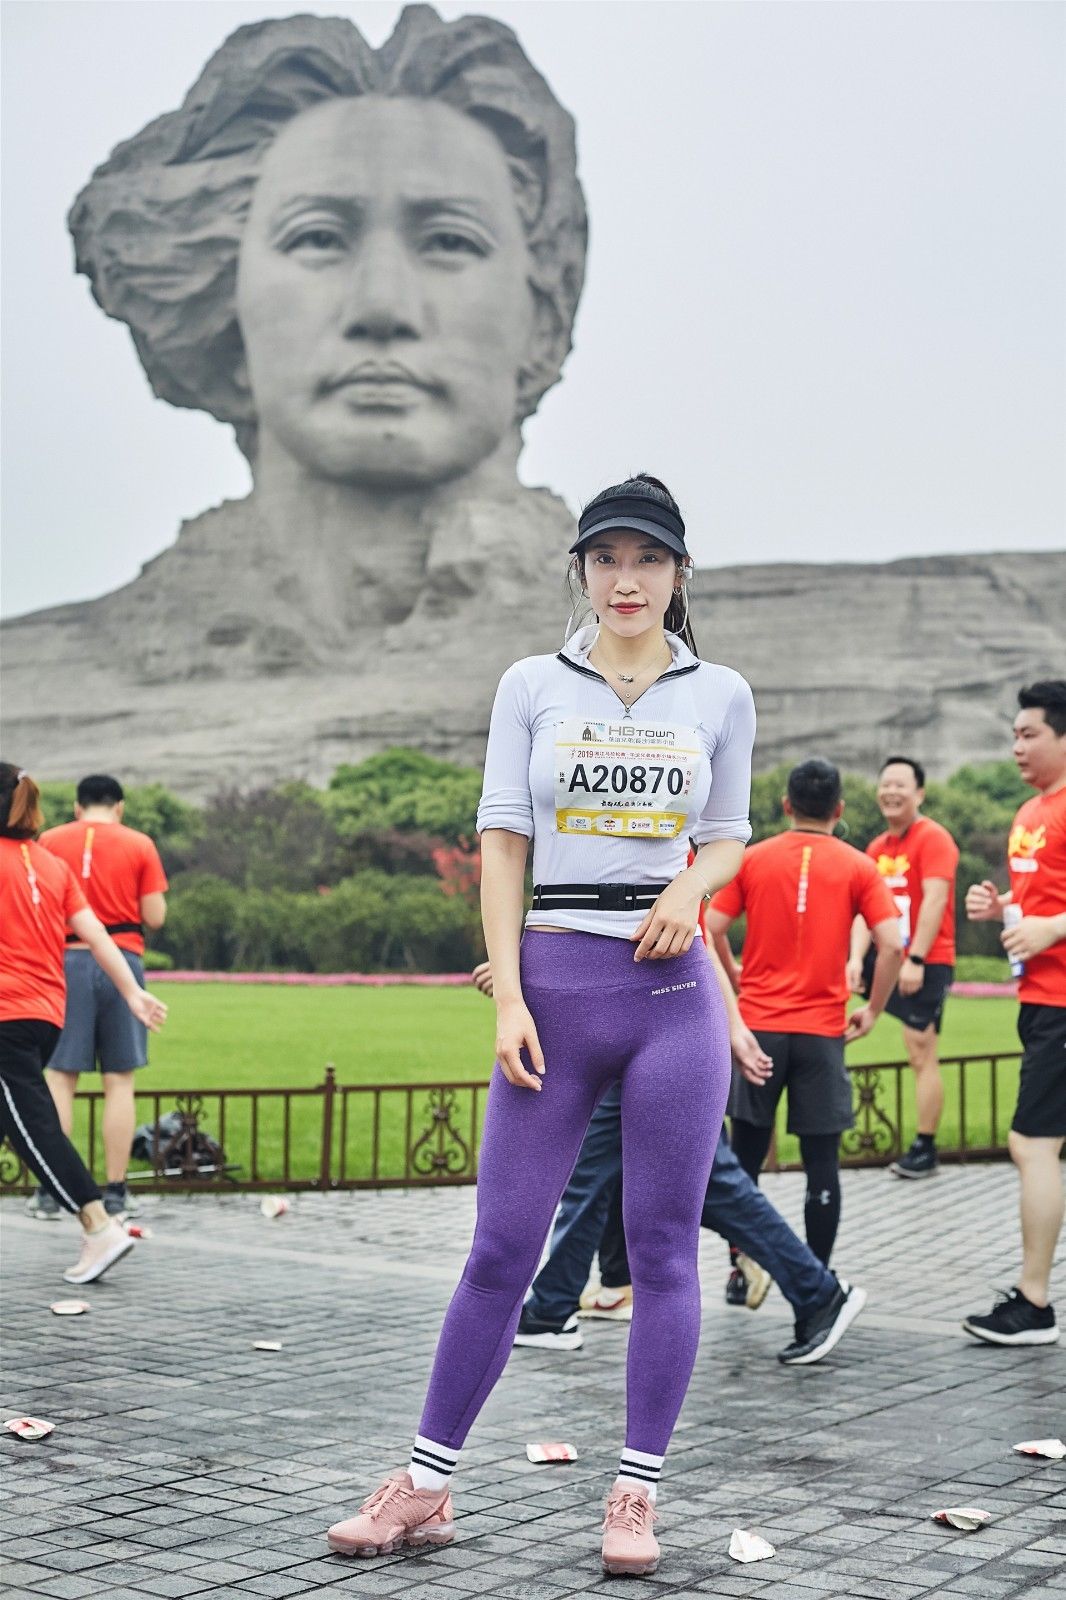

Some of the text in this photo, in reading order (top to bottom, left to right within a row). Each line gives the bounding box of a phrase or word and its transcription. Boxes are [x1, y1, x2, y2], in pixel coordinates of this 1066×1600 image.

[577, 750, 594, 758] 2019
[568, 763, 684, 795] A20870
[651, 981, 697, 996] MISS SILVER
